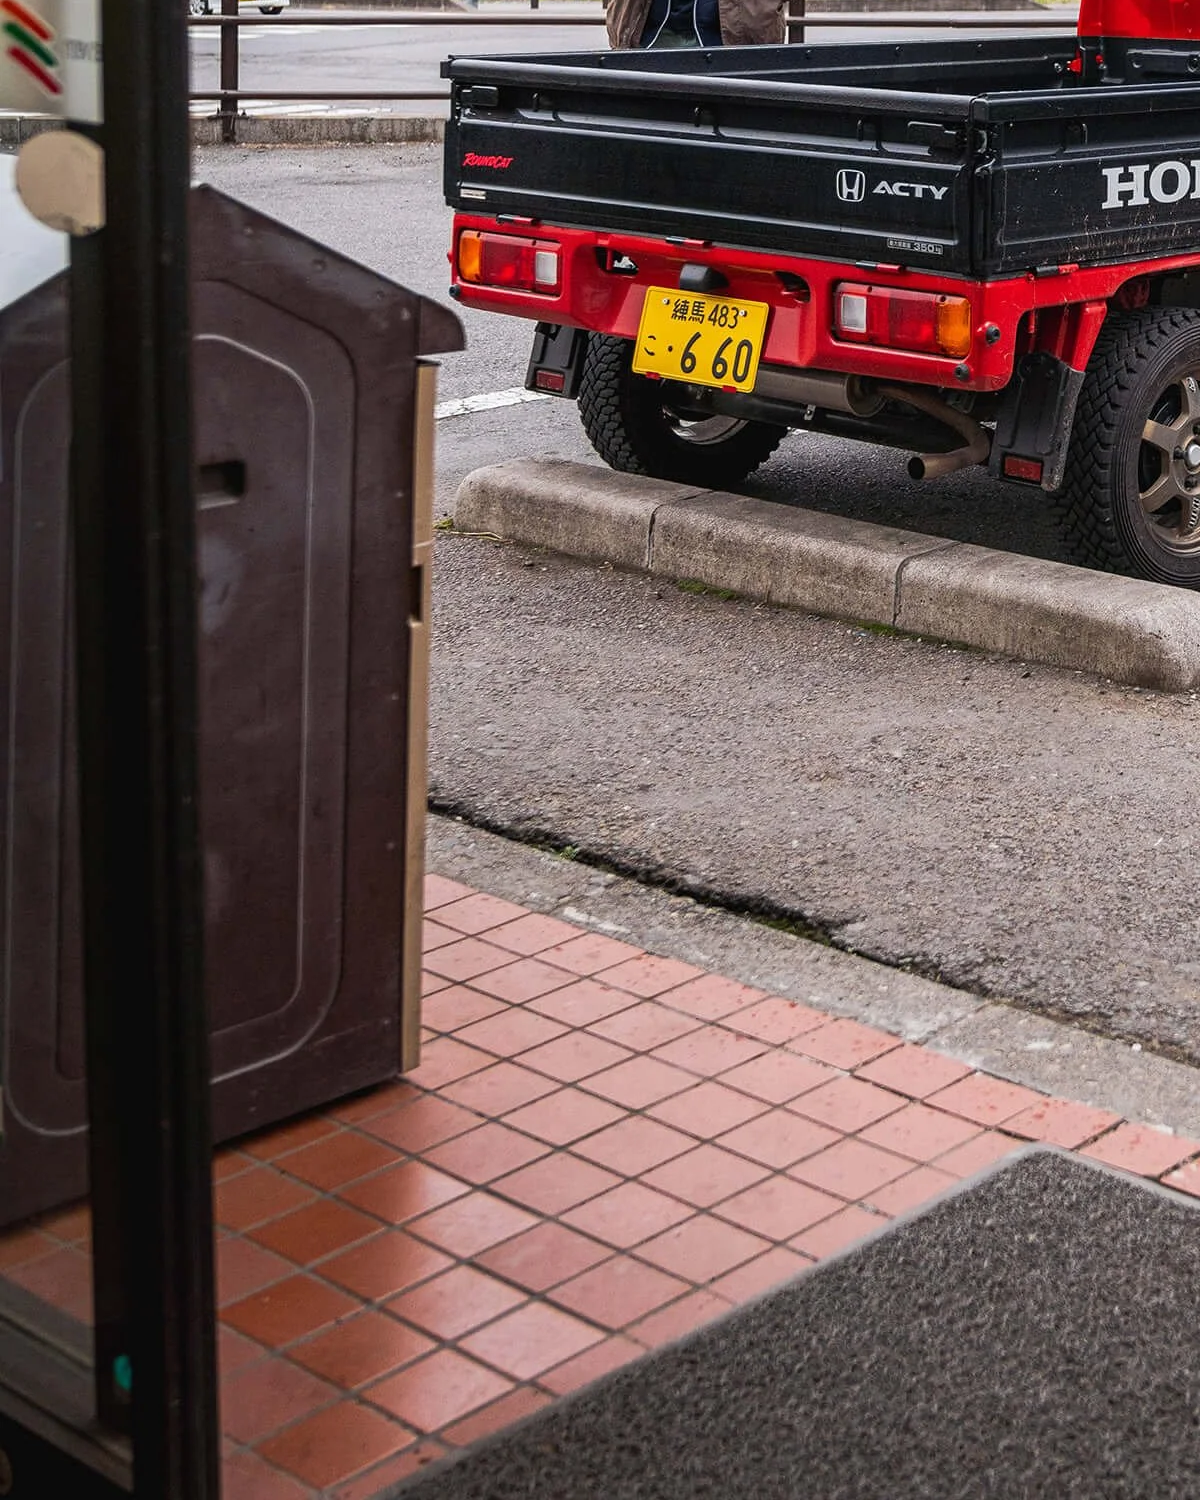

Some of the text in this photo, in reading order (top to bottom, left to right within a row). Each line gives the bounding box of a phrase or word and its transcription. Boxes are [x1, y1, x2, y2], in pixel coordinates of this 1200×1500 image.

[872, 180, 949, 200] ACTY
[671, 298, 740, 329] 練馬 483
[643, 335, 657, 356] こ
